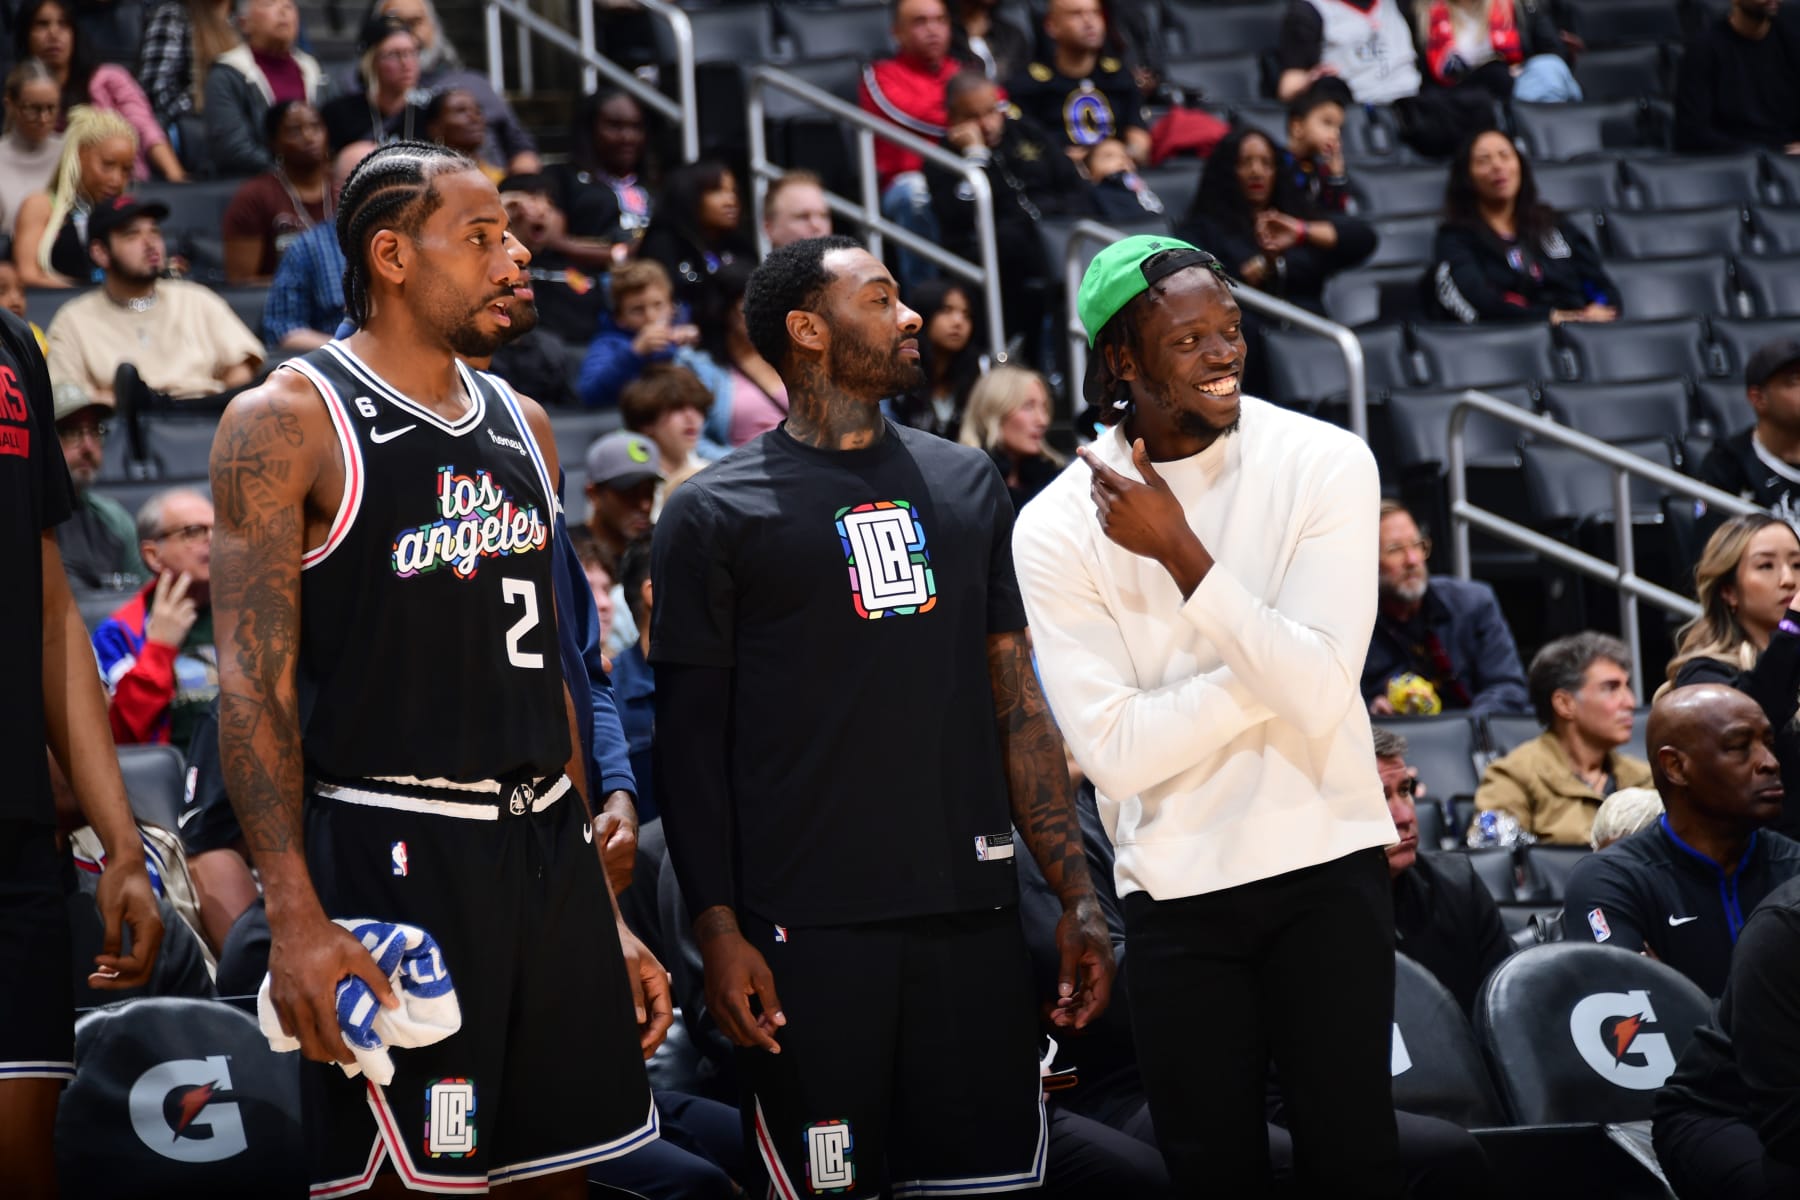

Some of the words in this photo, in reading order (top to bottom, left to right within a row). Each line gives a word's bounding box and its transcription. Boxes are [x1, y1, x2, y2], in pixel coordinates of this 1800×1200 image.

[355, 397, 377, 418] 6
[487, 428, 527, 456] honey
[439, 471, 503, 519] los
[393, 502, 547, 575] angeles
[502, 577, 544, 669] 2
[1570, 990, 1677, 1090] G
[128, 1055, 248, 1163] G
